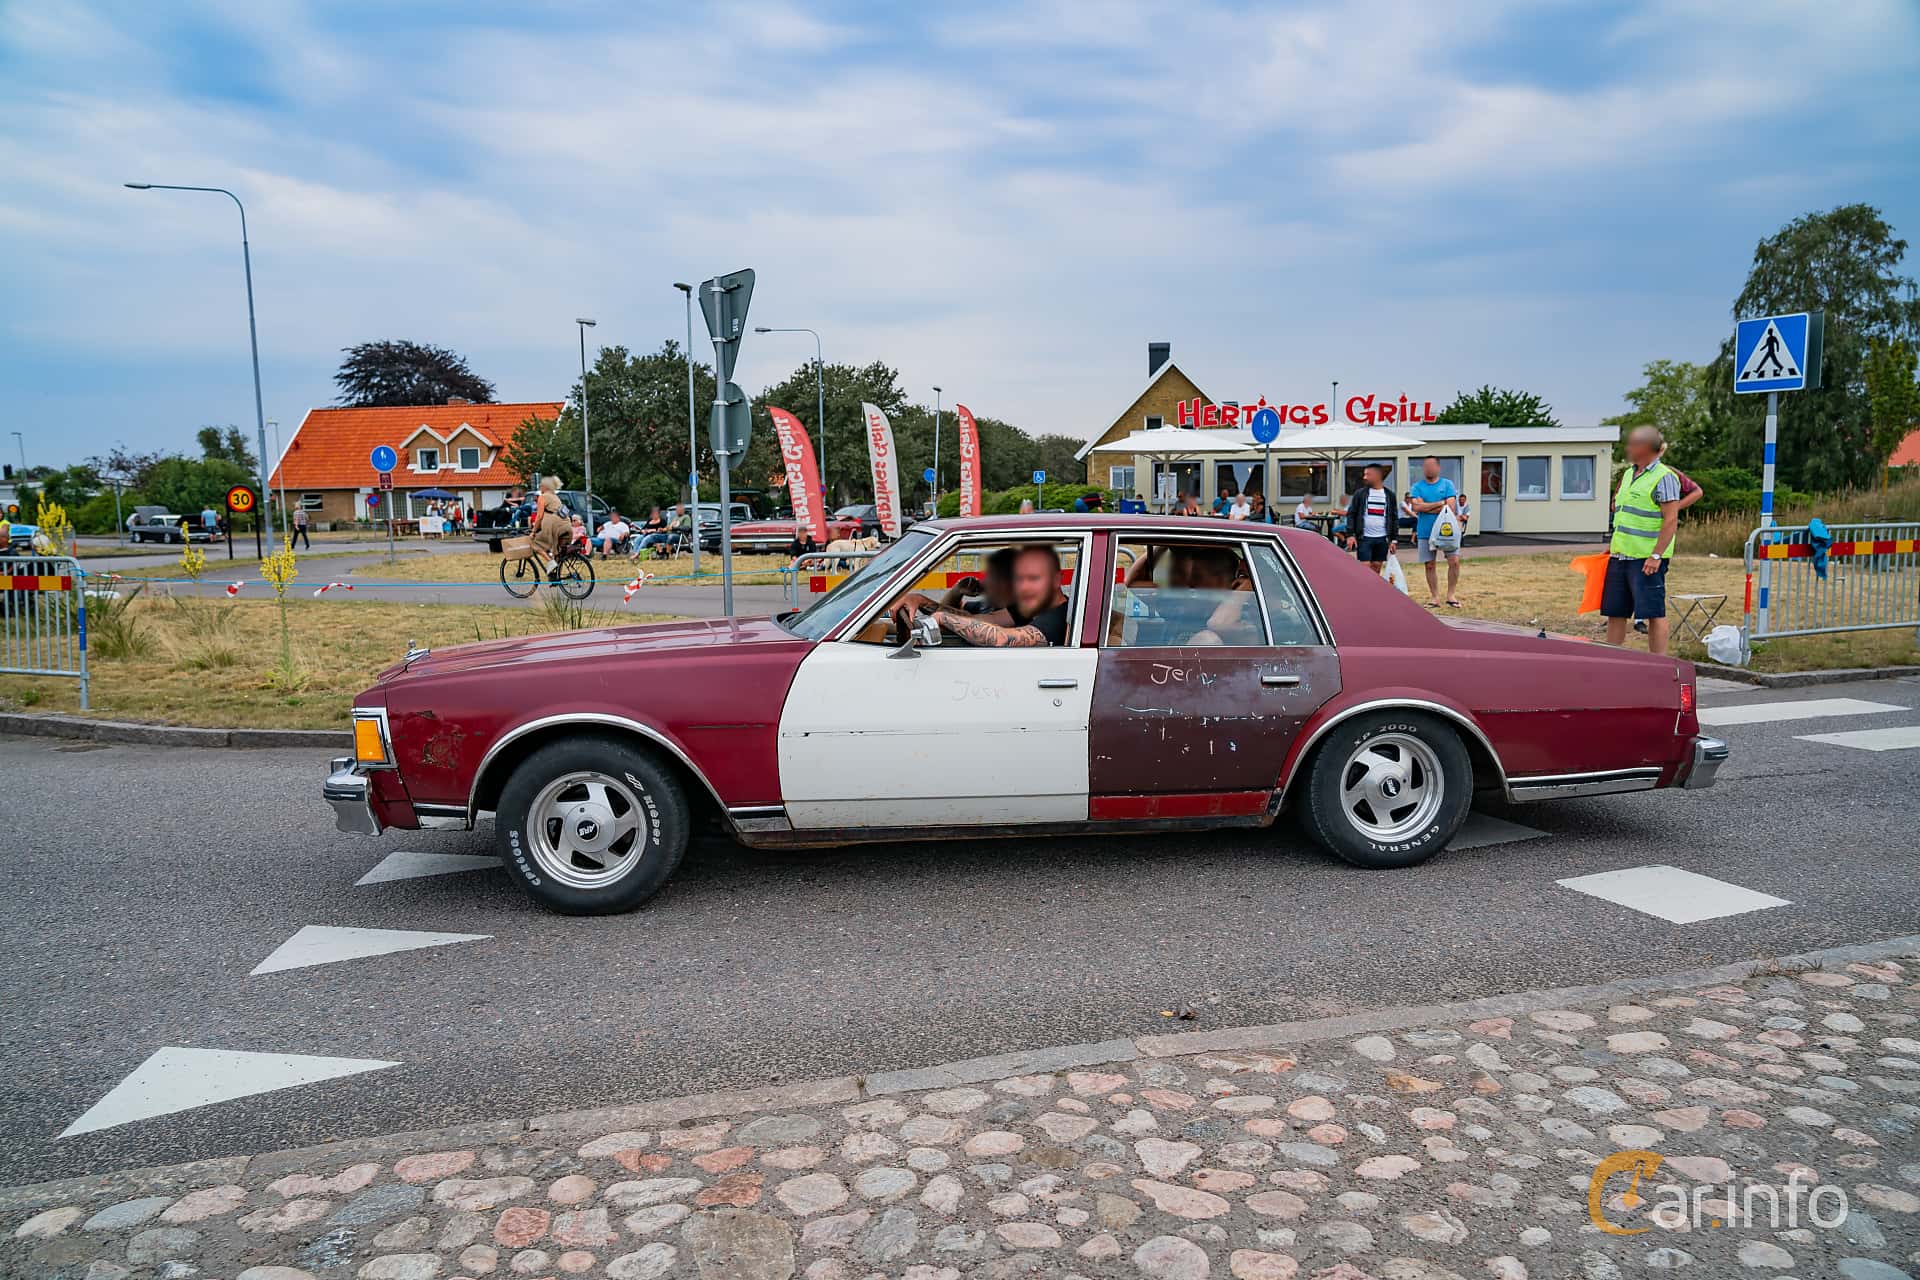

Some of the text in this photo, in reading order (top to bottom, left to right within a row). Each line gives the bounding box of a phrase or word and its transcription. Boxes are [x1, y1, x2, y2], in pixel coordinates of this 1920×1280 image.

[232, 493, 250, 506] 30
[1379, 723, 1417, 733] 2000
[1367, 825, 1440, 852] GENERAL
